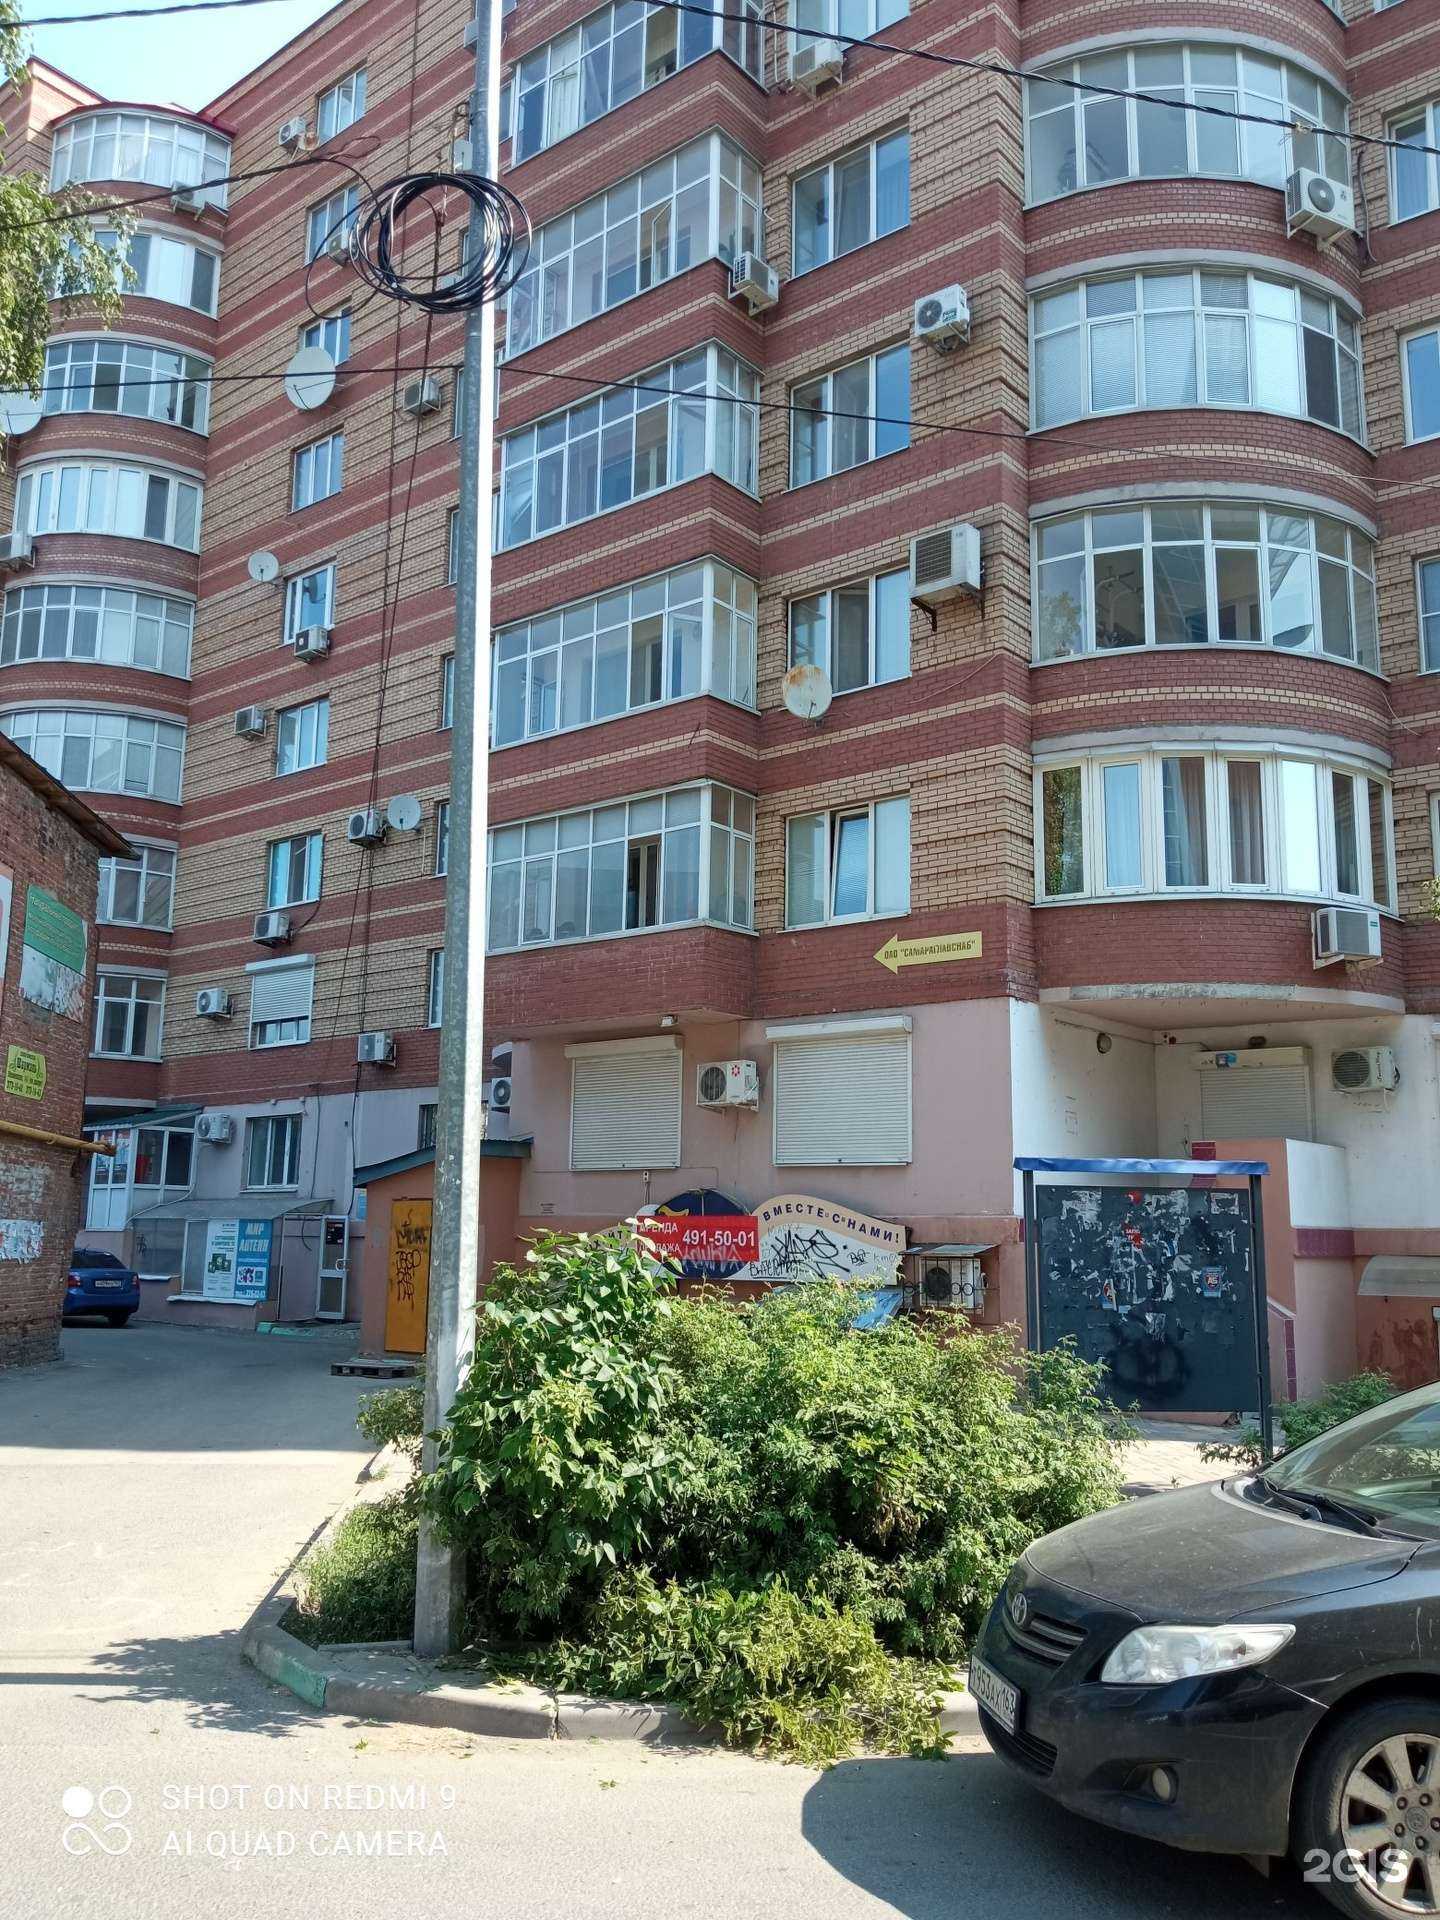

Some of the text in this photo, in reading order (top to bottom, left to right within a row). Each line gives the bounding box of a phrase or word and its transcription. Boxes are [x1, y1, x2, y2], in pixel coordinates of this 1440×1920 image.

[683, 1229, 755, 1247] 491-50-01
[762, 1203, 900, 1244] ВМЕСТЕ С НАМИ!
